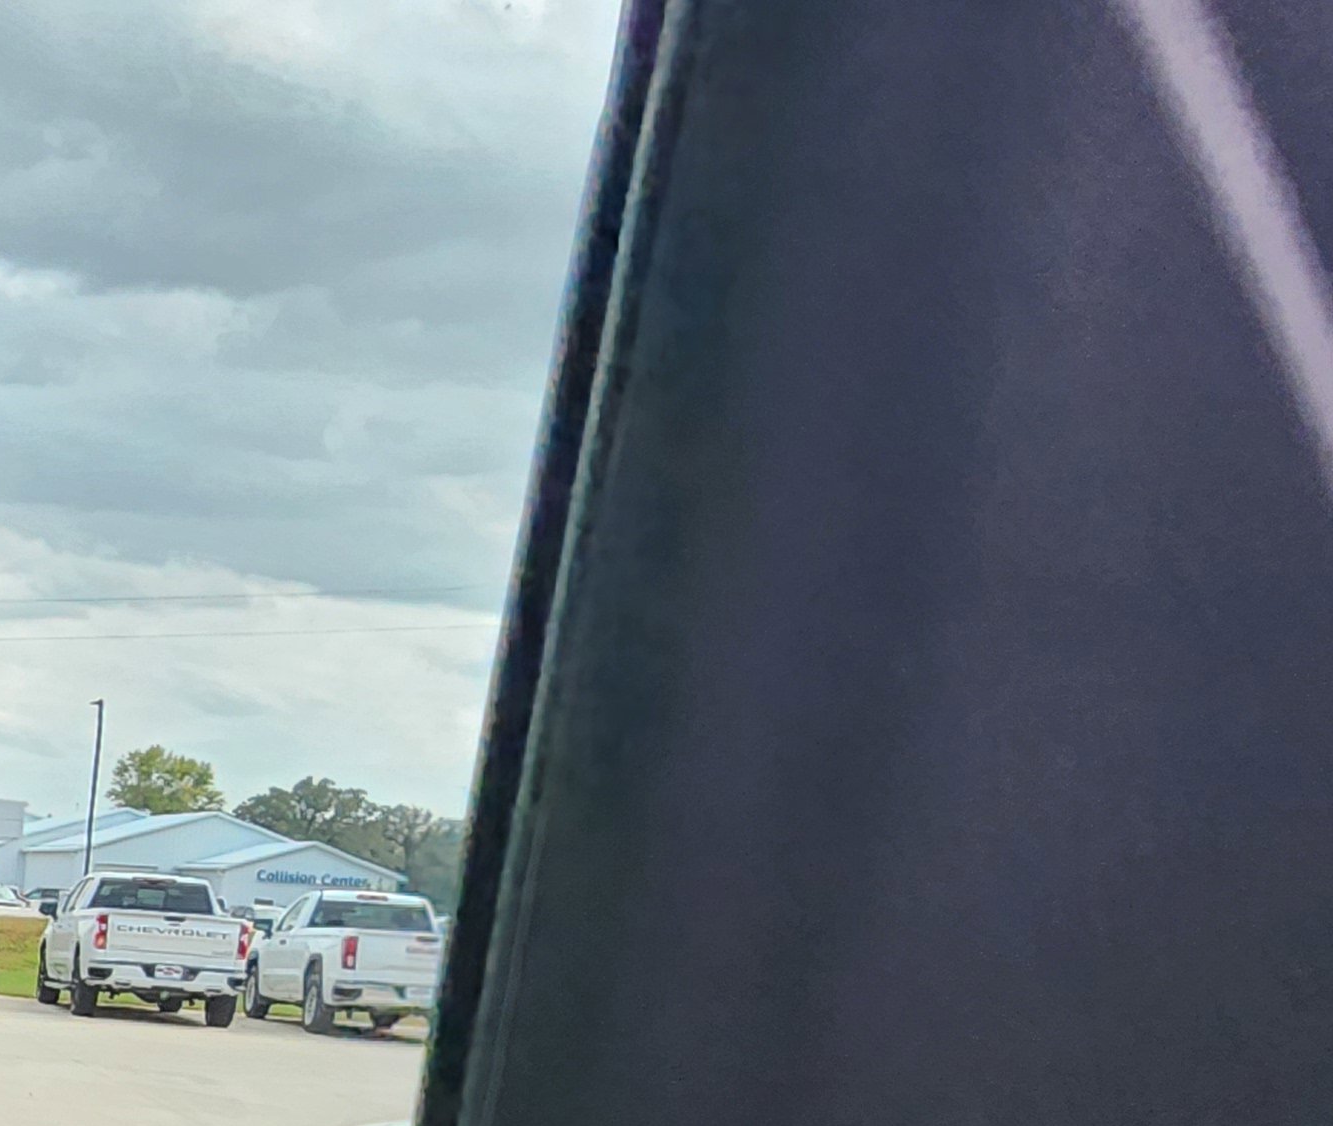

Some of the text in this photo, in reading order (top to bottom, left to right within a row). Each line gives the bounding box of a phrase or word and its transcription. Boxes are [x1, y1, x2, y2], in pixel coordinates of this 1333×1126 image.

[256, 869, 369, 888] Collision Center
[116, 924, 232, 940] CHEVROLET
